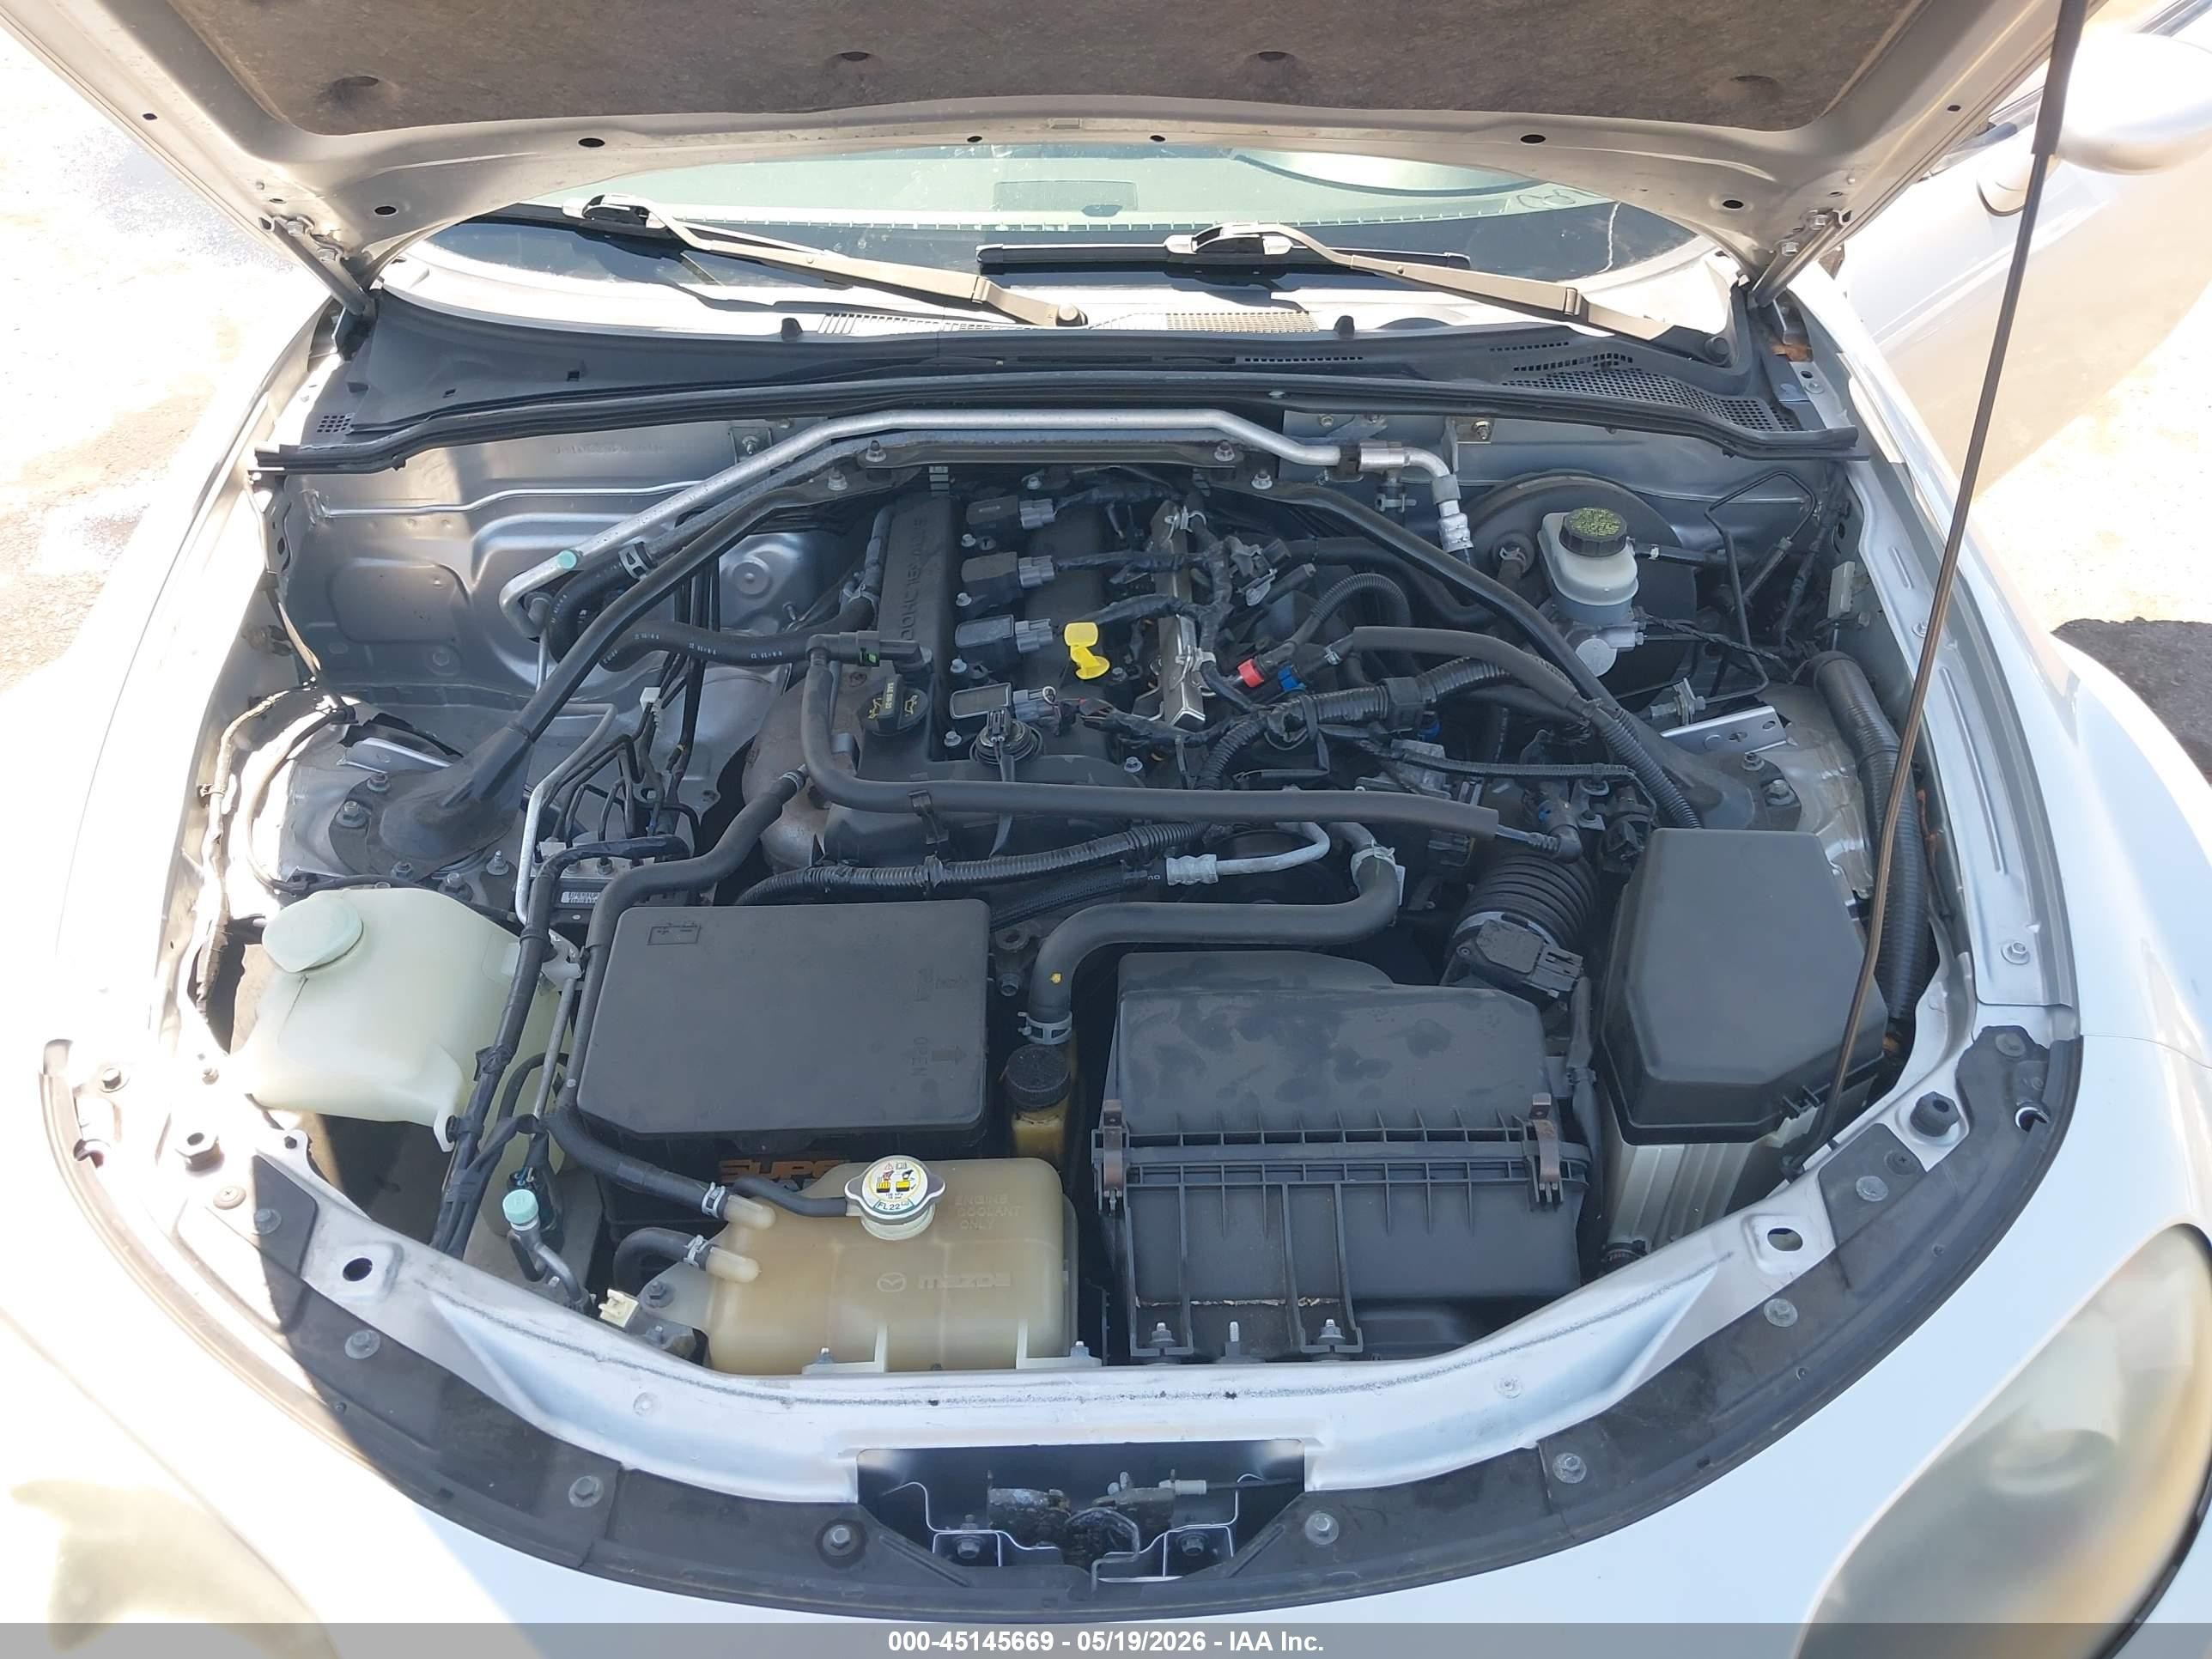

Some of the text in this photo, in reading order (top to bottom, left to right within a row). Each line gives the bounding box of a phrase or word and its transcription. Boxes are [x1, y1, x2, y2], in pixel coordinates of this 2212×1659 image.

[912, 1036, 928, 1076] OPEN
[877, 1201, 901, 1210] FL22
[954, 1194, 1008, 1206] ENGINE
[957, 1204, 1023, 1217] COOLANT
[961, 1219, 997, 1231] ONLY
